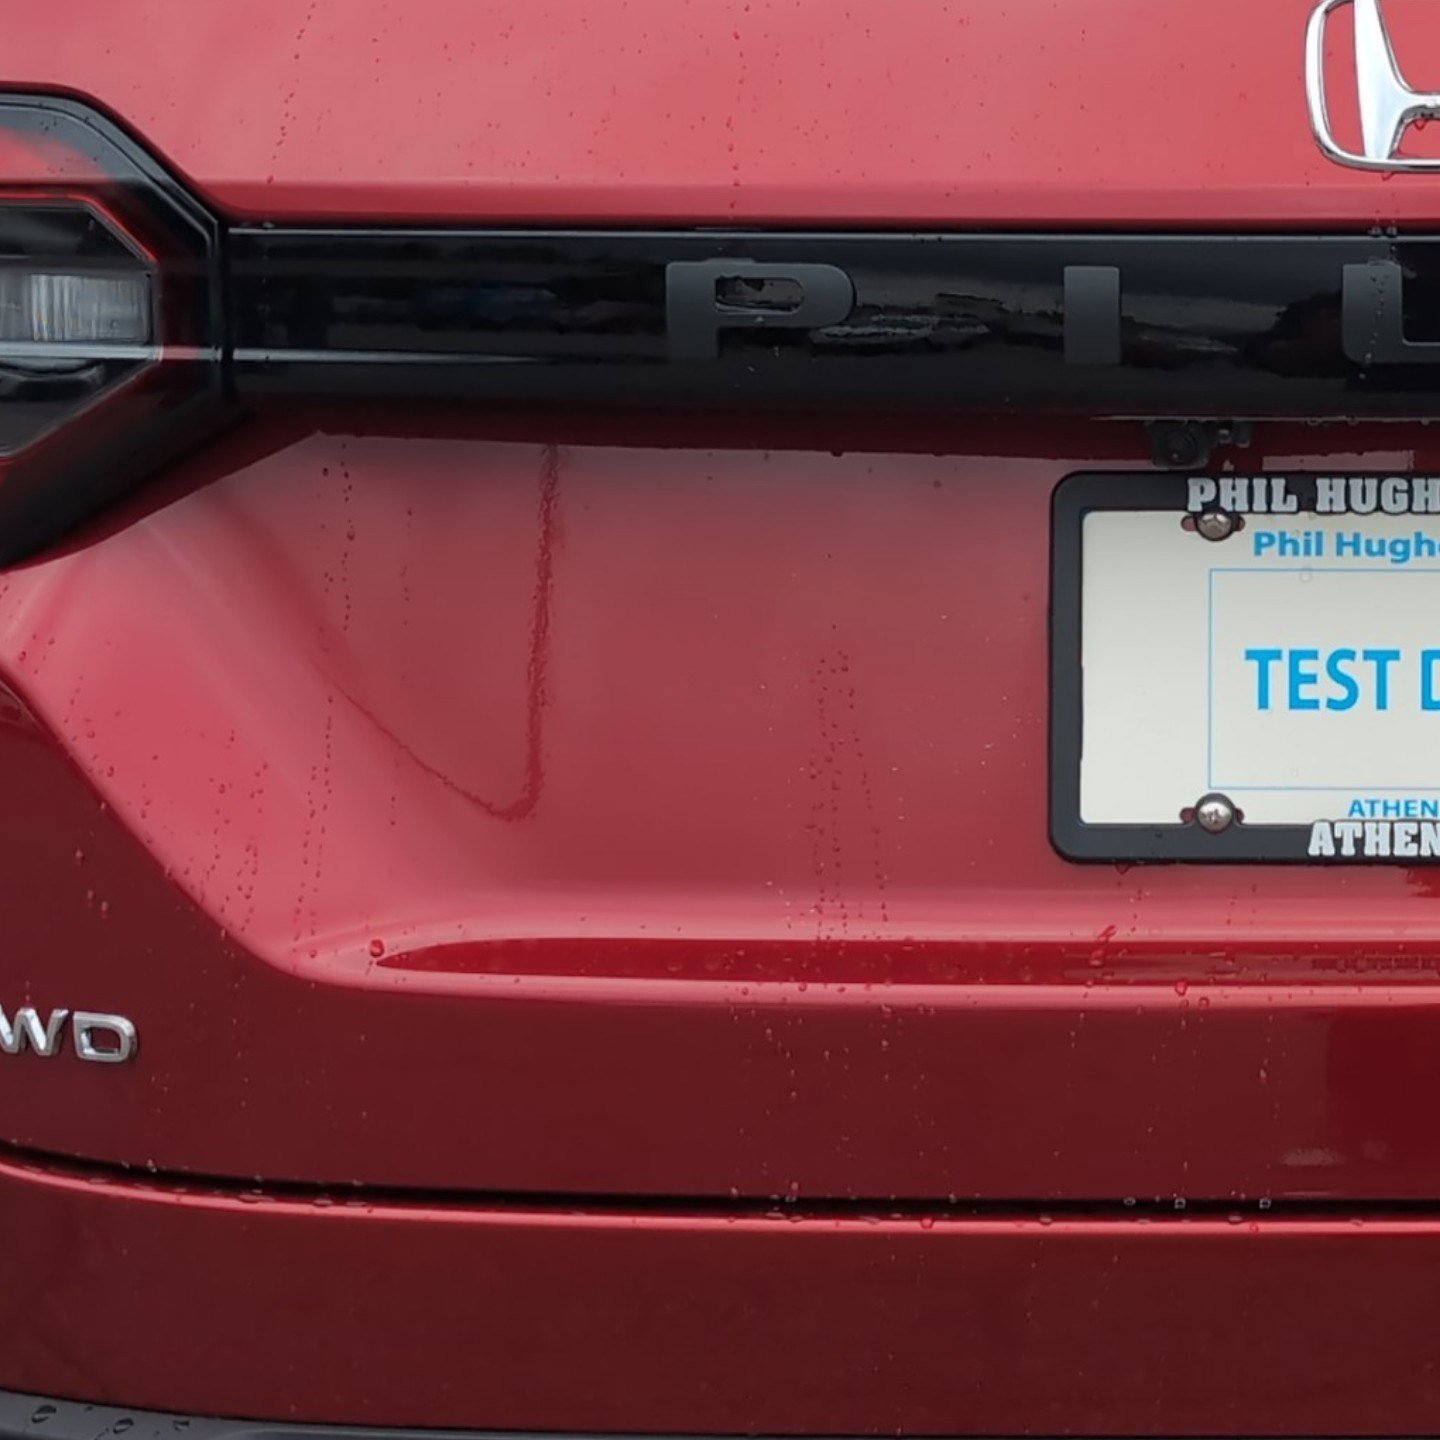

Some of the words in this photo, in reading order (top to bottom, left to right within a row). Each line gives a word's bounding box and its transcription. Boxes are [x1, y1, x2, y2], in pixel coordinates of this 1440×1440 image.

[1187, 477, 1298, 513] PHIL
[1253, 531, 1323, 558] Phil
[1244, 648, 1401, 712] TEST
